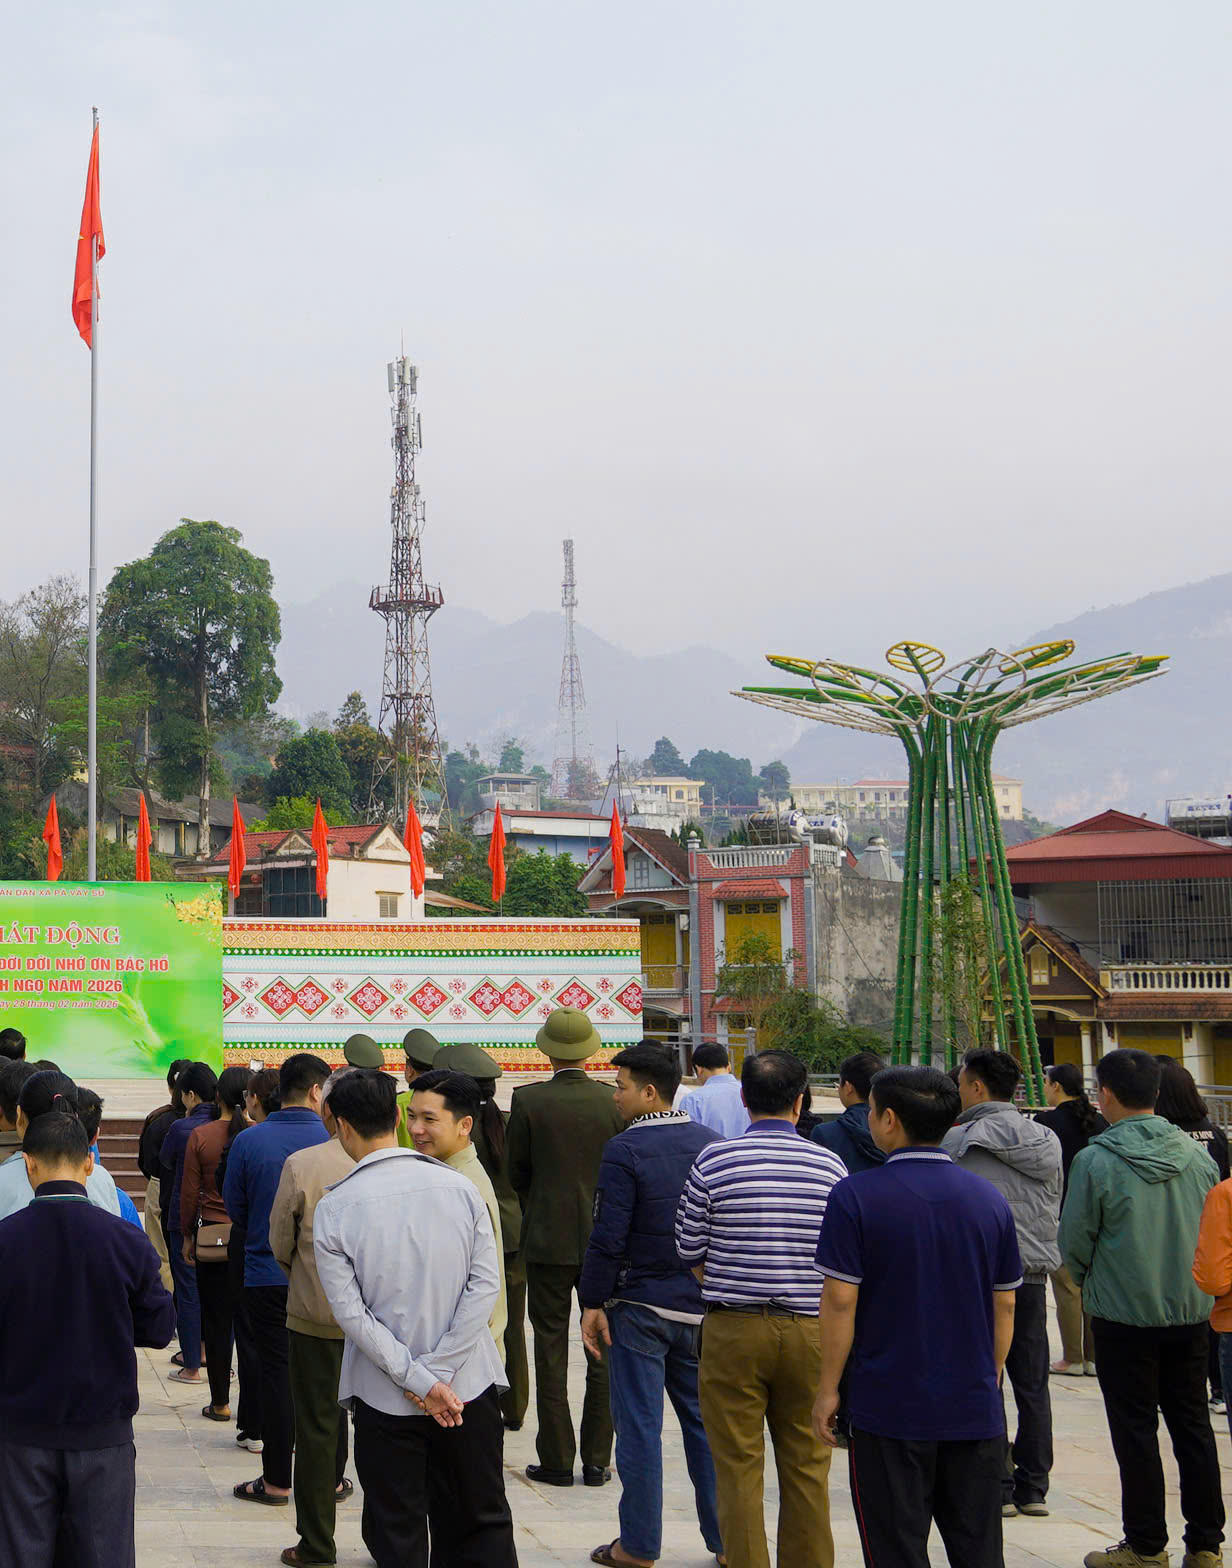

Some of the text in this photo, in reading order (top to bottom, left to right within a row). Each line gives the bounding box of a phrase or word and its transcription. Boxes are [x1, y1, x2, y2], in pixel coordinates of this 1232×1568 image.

[47, 921, 120, 948] ĐỘNG
[26, 955, 50, 970] ĐỜI
[55, 955, 86, 971] NHỚ
[90, 956, 111, 971] ƠN
[115, 956, 145, 971] BÁC
[149, 955, 169, 971] HỒ
[13, 979, 44, 994] NGỌ
[48, 976, 83, 992] NĂM
[87, 980, 123, 992] 2026
[13, 1000, 26, 1008] 28
[27, 999, 55, 1010] tháng
[57, 1000, 70, 1008] 02
[71, 999, 93, 1008] năm
[95, 1000, 119, 1008] 2026
